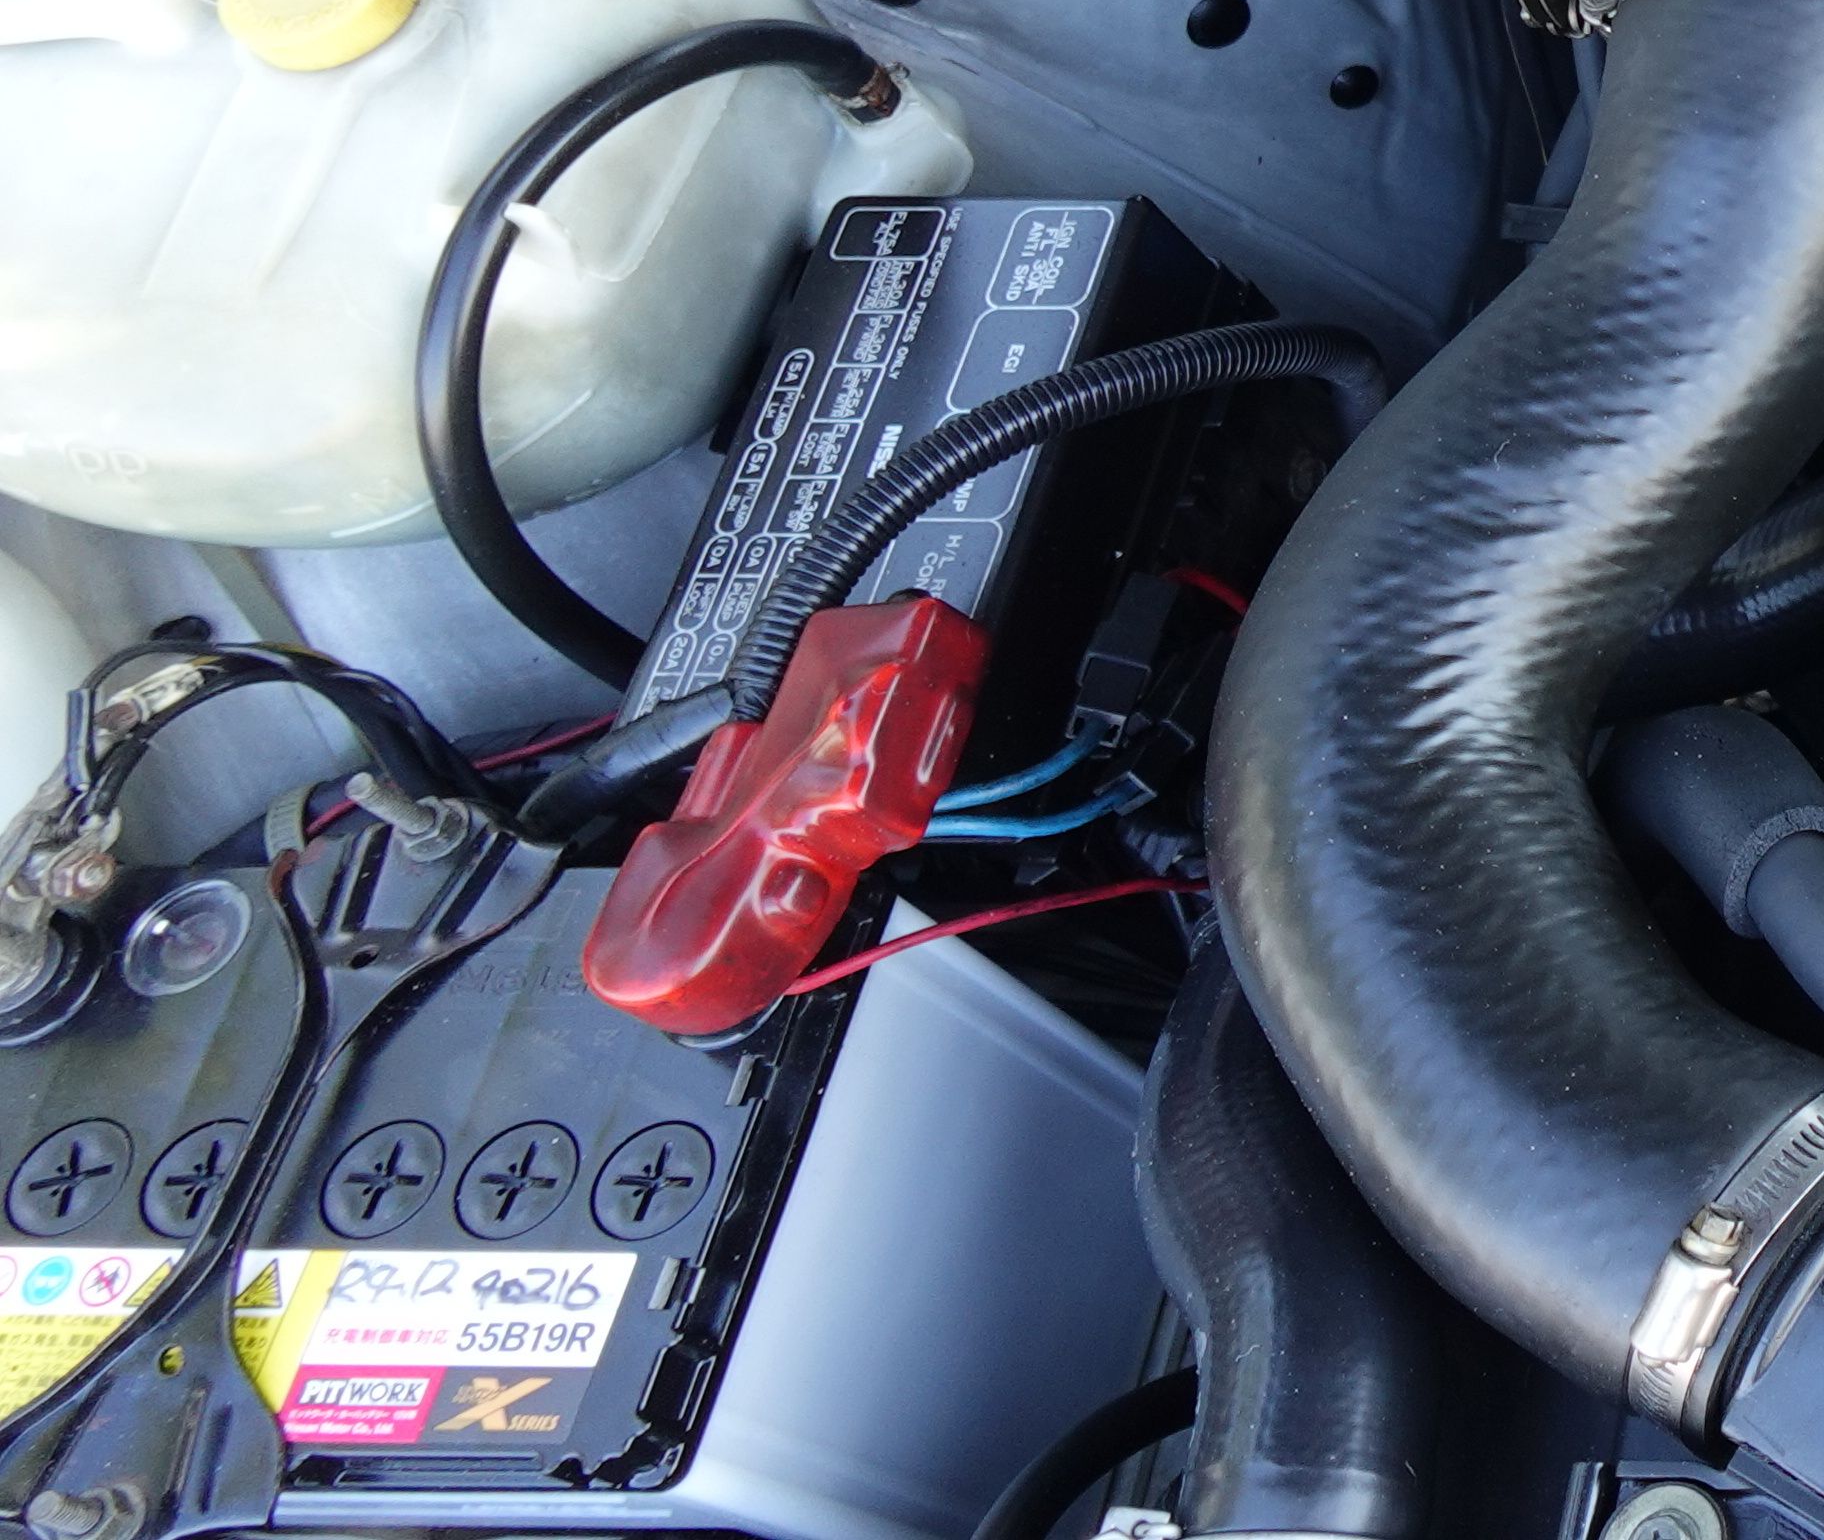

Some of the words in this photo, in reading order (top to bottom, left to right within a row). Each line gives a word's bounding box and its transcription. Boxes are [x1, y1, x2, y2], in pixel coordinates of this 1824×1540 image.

[945, 207, 963, 232] USE
[1055, 220, 1078, 250] IGN
[1020, 220, 1046, 258] ANTI
[919, 235, 953, 298] SPECIFIED
[1004, 264, 1031, 302] SKID
[1043, 255, 1065, 291] COIL
[902, 301, 928, 344] FUSES
[784, 354, 808, 383] 15A
[888, 345, 910, 380] ONLY
[1001, 343, 1026, 375] EGI
[745, 444, 769, 475] 15A
[798, 431, 820, 469] CONT
[705, 538, 731, 569] 10A
[744, 538, 769, 569] 10A
[683, 581, 705, 618] LOCK
[720, 581, 744, 623] PUMP
[731, 581, 757, 620] FUEL
[664, 635, 690, 671] 20A
[456, 1321, 596, 1353] 55B19R
[507, 1414, 560, 1432] SERIES
